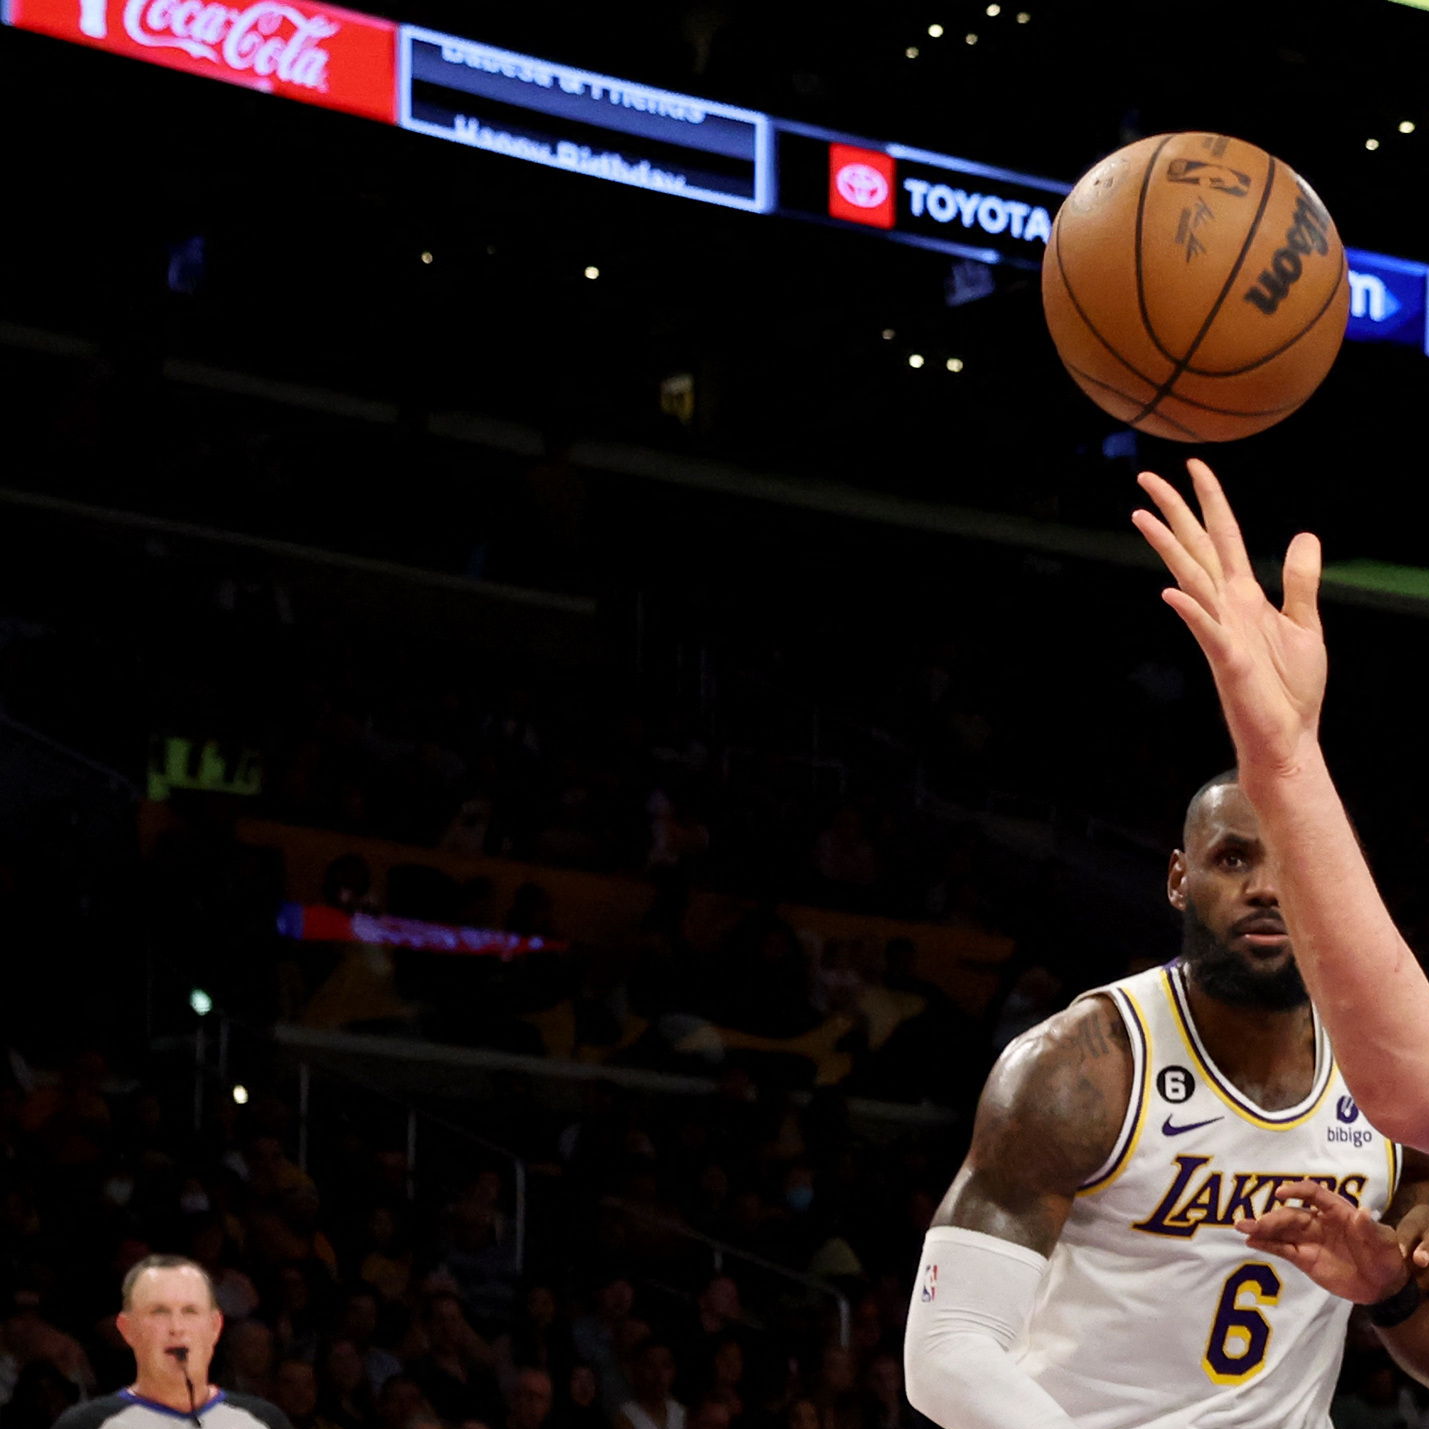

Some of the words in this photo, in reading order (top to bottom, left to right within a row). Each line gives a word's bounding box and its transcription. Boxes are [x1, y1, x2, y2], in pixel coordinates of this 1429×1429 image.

[903, 176, 1052, 245] TOYOTA
[1163, 1069, 1187, 1101] 6
[1327, 1126, 1373, 1148] bibigo
[1202, 1260, 1283, 1386] 6
